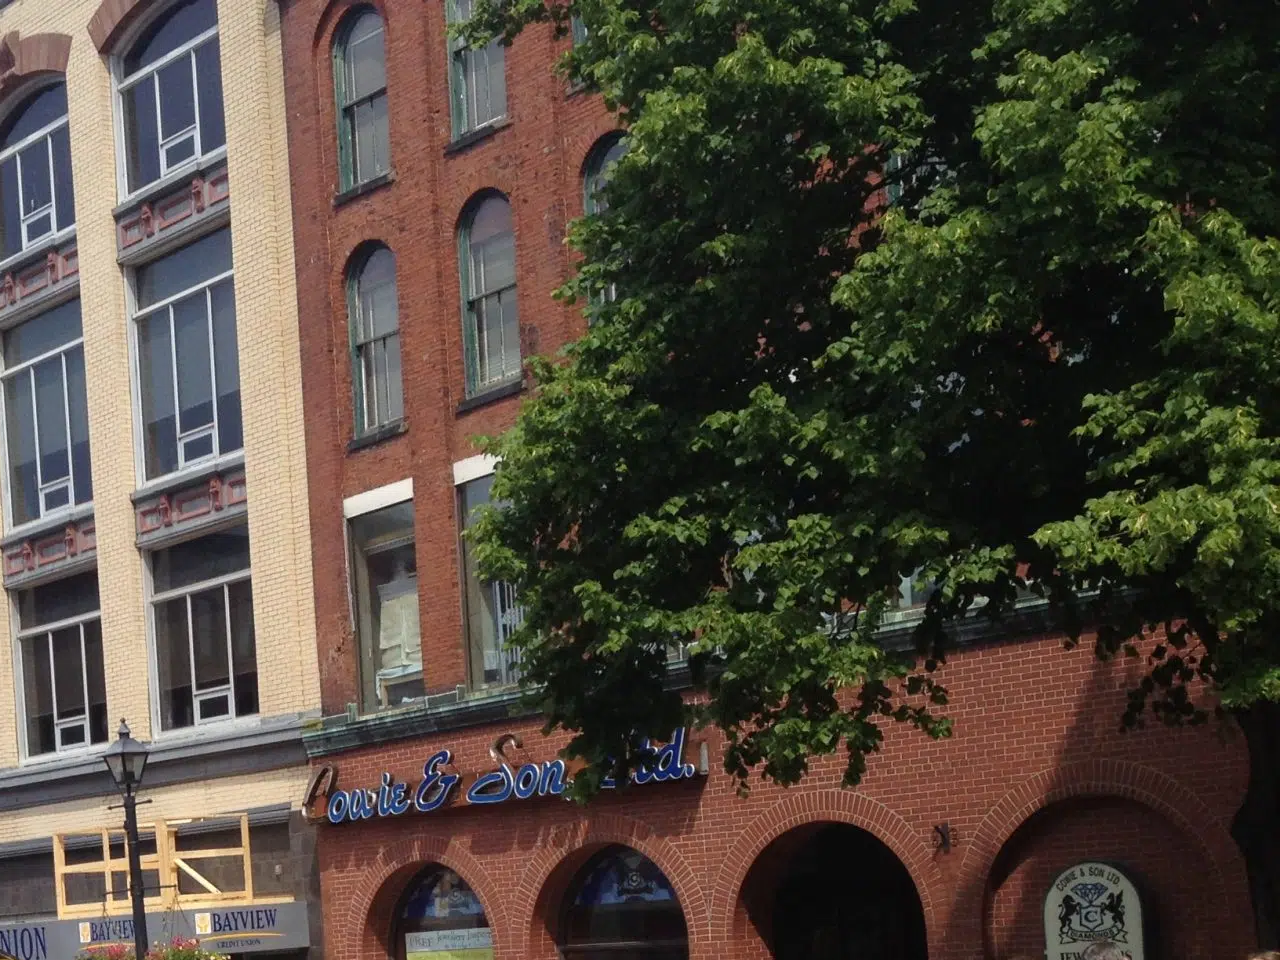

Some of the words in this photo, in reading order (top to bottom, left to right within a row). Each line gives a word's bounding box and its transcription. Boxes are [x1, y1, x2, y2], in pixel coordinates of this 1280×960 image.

[415, 749, 461, 812] &
[1056, 871, 1078, 892] COWIE
[1088, 866, 1106, 878] SON
[212, 908, 277, 932] BAYVIEW
[1084, 910, 1098, 922] C
[217, 940, 239, 949] CREDIT
